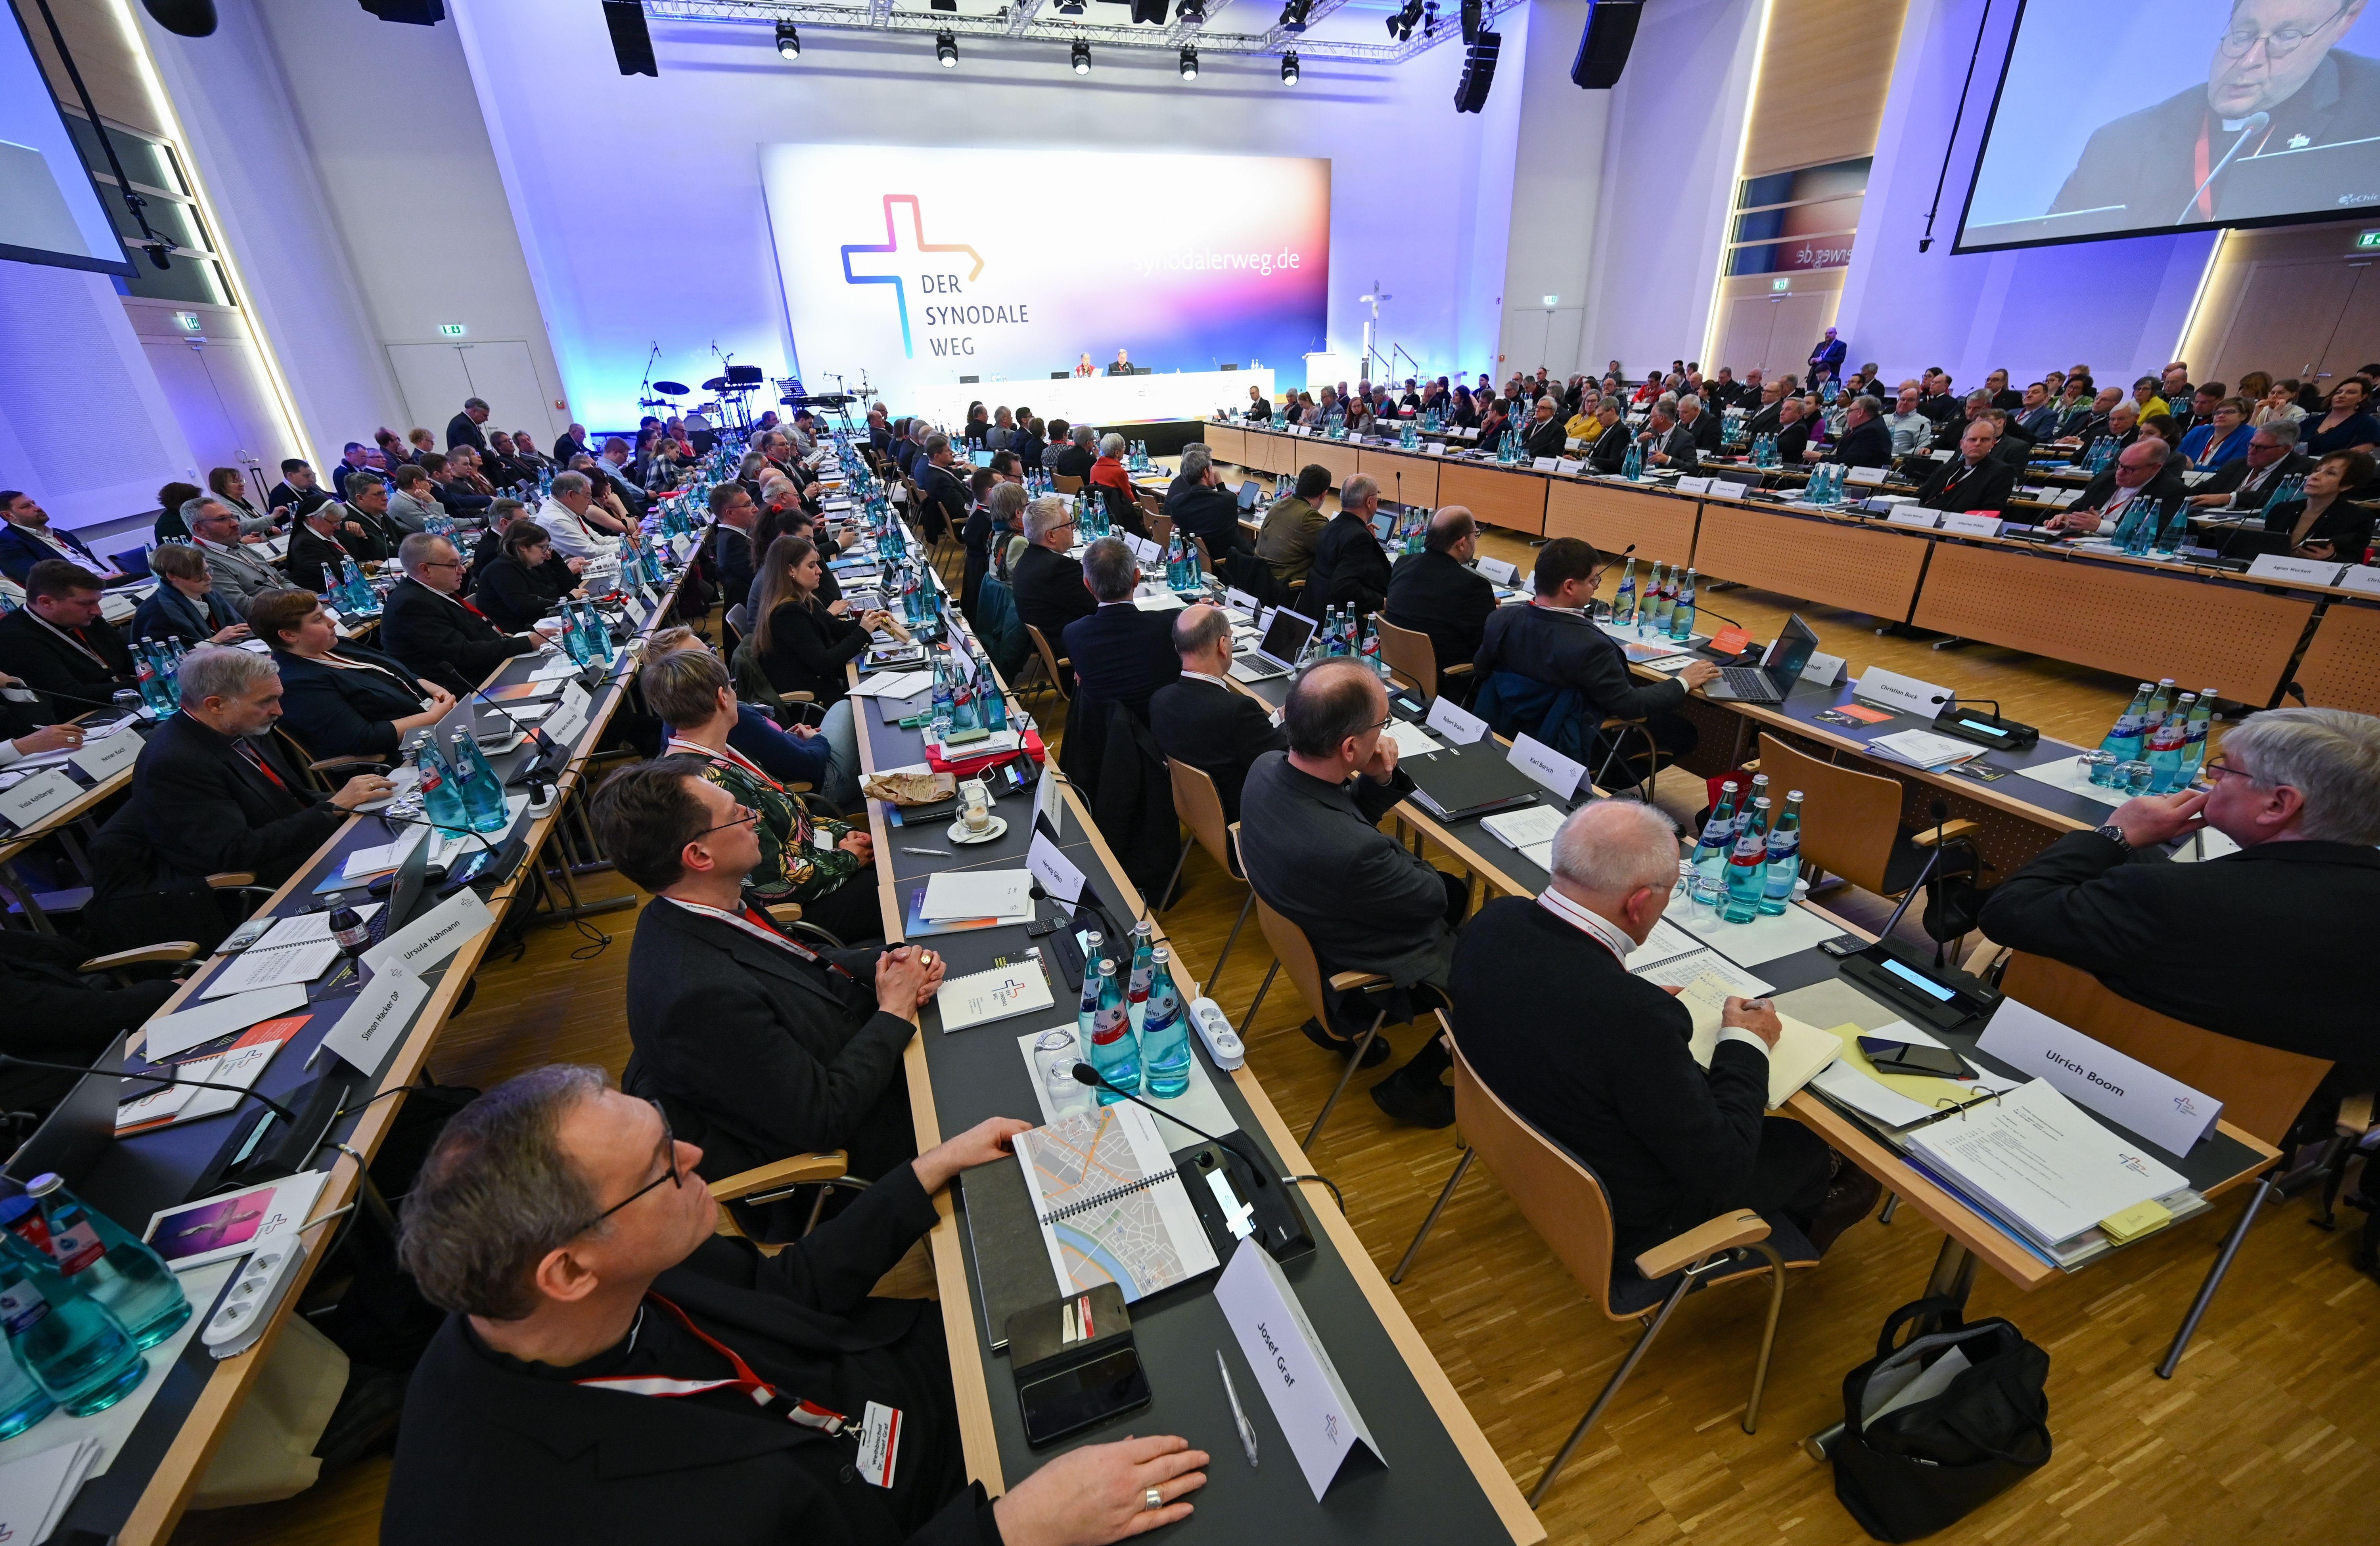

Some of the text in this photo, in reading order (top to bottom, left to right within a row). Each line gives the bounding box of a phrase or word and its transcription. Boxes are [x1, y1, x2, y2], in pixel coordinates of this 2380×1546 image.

[1134, 247, 1299, 277] synodalerweg.de
[922, 274, 962, 293] DER
[926, 305, 1029, 325] SYNODALE
[929, 337, 974, 356] WEG
[1880, 684, 1918, 700] Christian Bock
[1443, 716, 1465, 733] Robert Brahm
[101, 753, 116, 762] Heiner
[1530, 757, 1554, 774] Karl Borsch
[1042, 858, 1063, 884] Herwig Gössl
[403, 920, 460, 960] Ursula Hahmann
[362, 991, 400, 1041] Simon Hacker OP
[2046, 1050, 2125, 1097] Ulrich Boom
[1258, 1321, 1295, 1388] Josef Graf
[872, 1423, 882, 1465] Weihbischof
